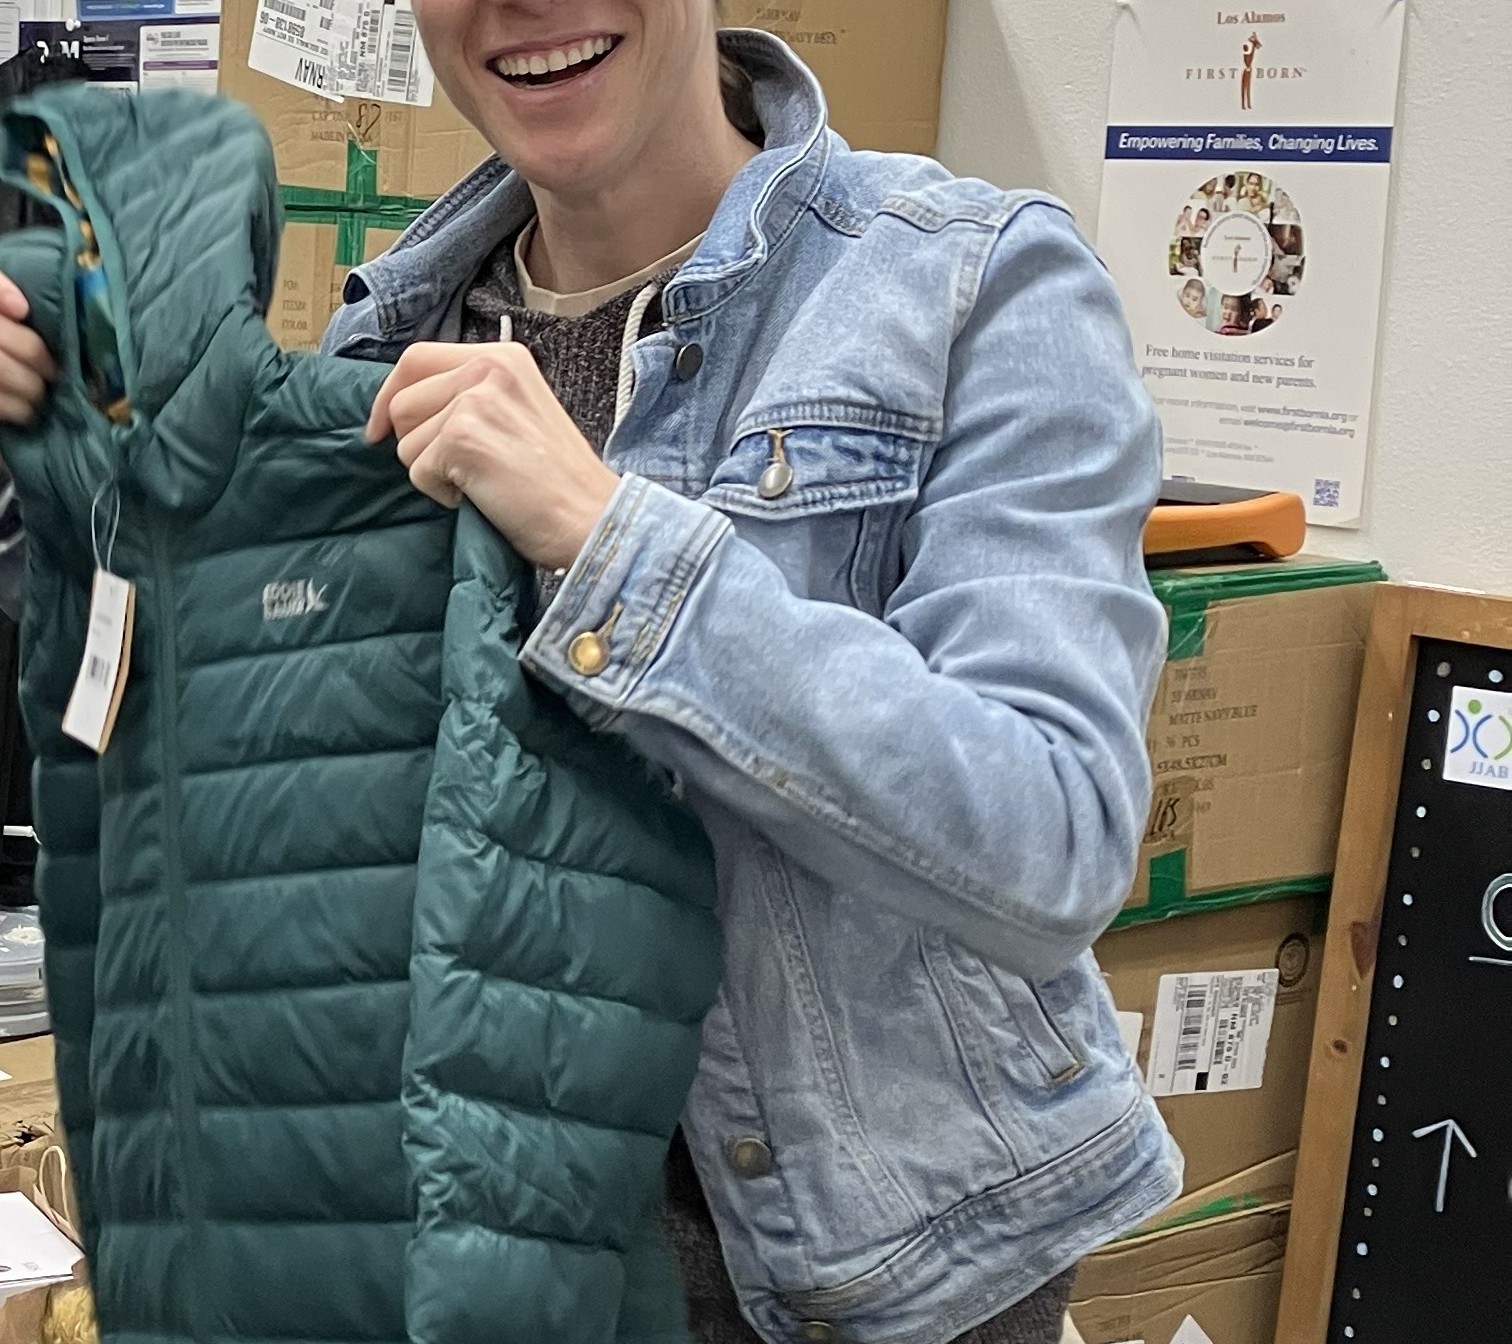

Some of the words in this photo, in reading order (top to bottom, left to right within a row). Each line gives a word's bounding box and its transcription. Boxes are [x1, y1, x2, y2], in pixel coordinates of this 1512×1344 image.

[1217, 12, 1238, 25] Los
[1241, 11, 1286, 24] Alamos
[359, 41, 367, 57] NM
[1185, 68, 1237, 80] FIRST
[1255, 67, 1304, 79] BORN
[1118, 133, 1204, 153] Empowering
[1205, 133, 1264, 153] Families,
[1268, 133, 1335, 154] Changing
[1337, 134, 1379, 152] Lives.
[1146, 344, 1169, 358] Free
[1171, 347, 1201, 360] home
[1203, 350, 1251, 364] visitation
[1253, 353, 1295, 367] services
[1297, 355, 1315, 369] for
[1142, 365, 1187, 380] pregnant
[1189, 368, 1227, 381] women
[1230, 370, 1250, 383] and
[1252, 373, 1274, 384] new
[1276, 375, 1317, 389] parents.
[1469, 761, 1509, 779] JJAB
